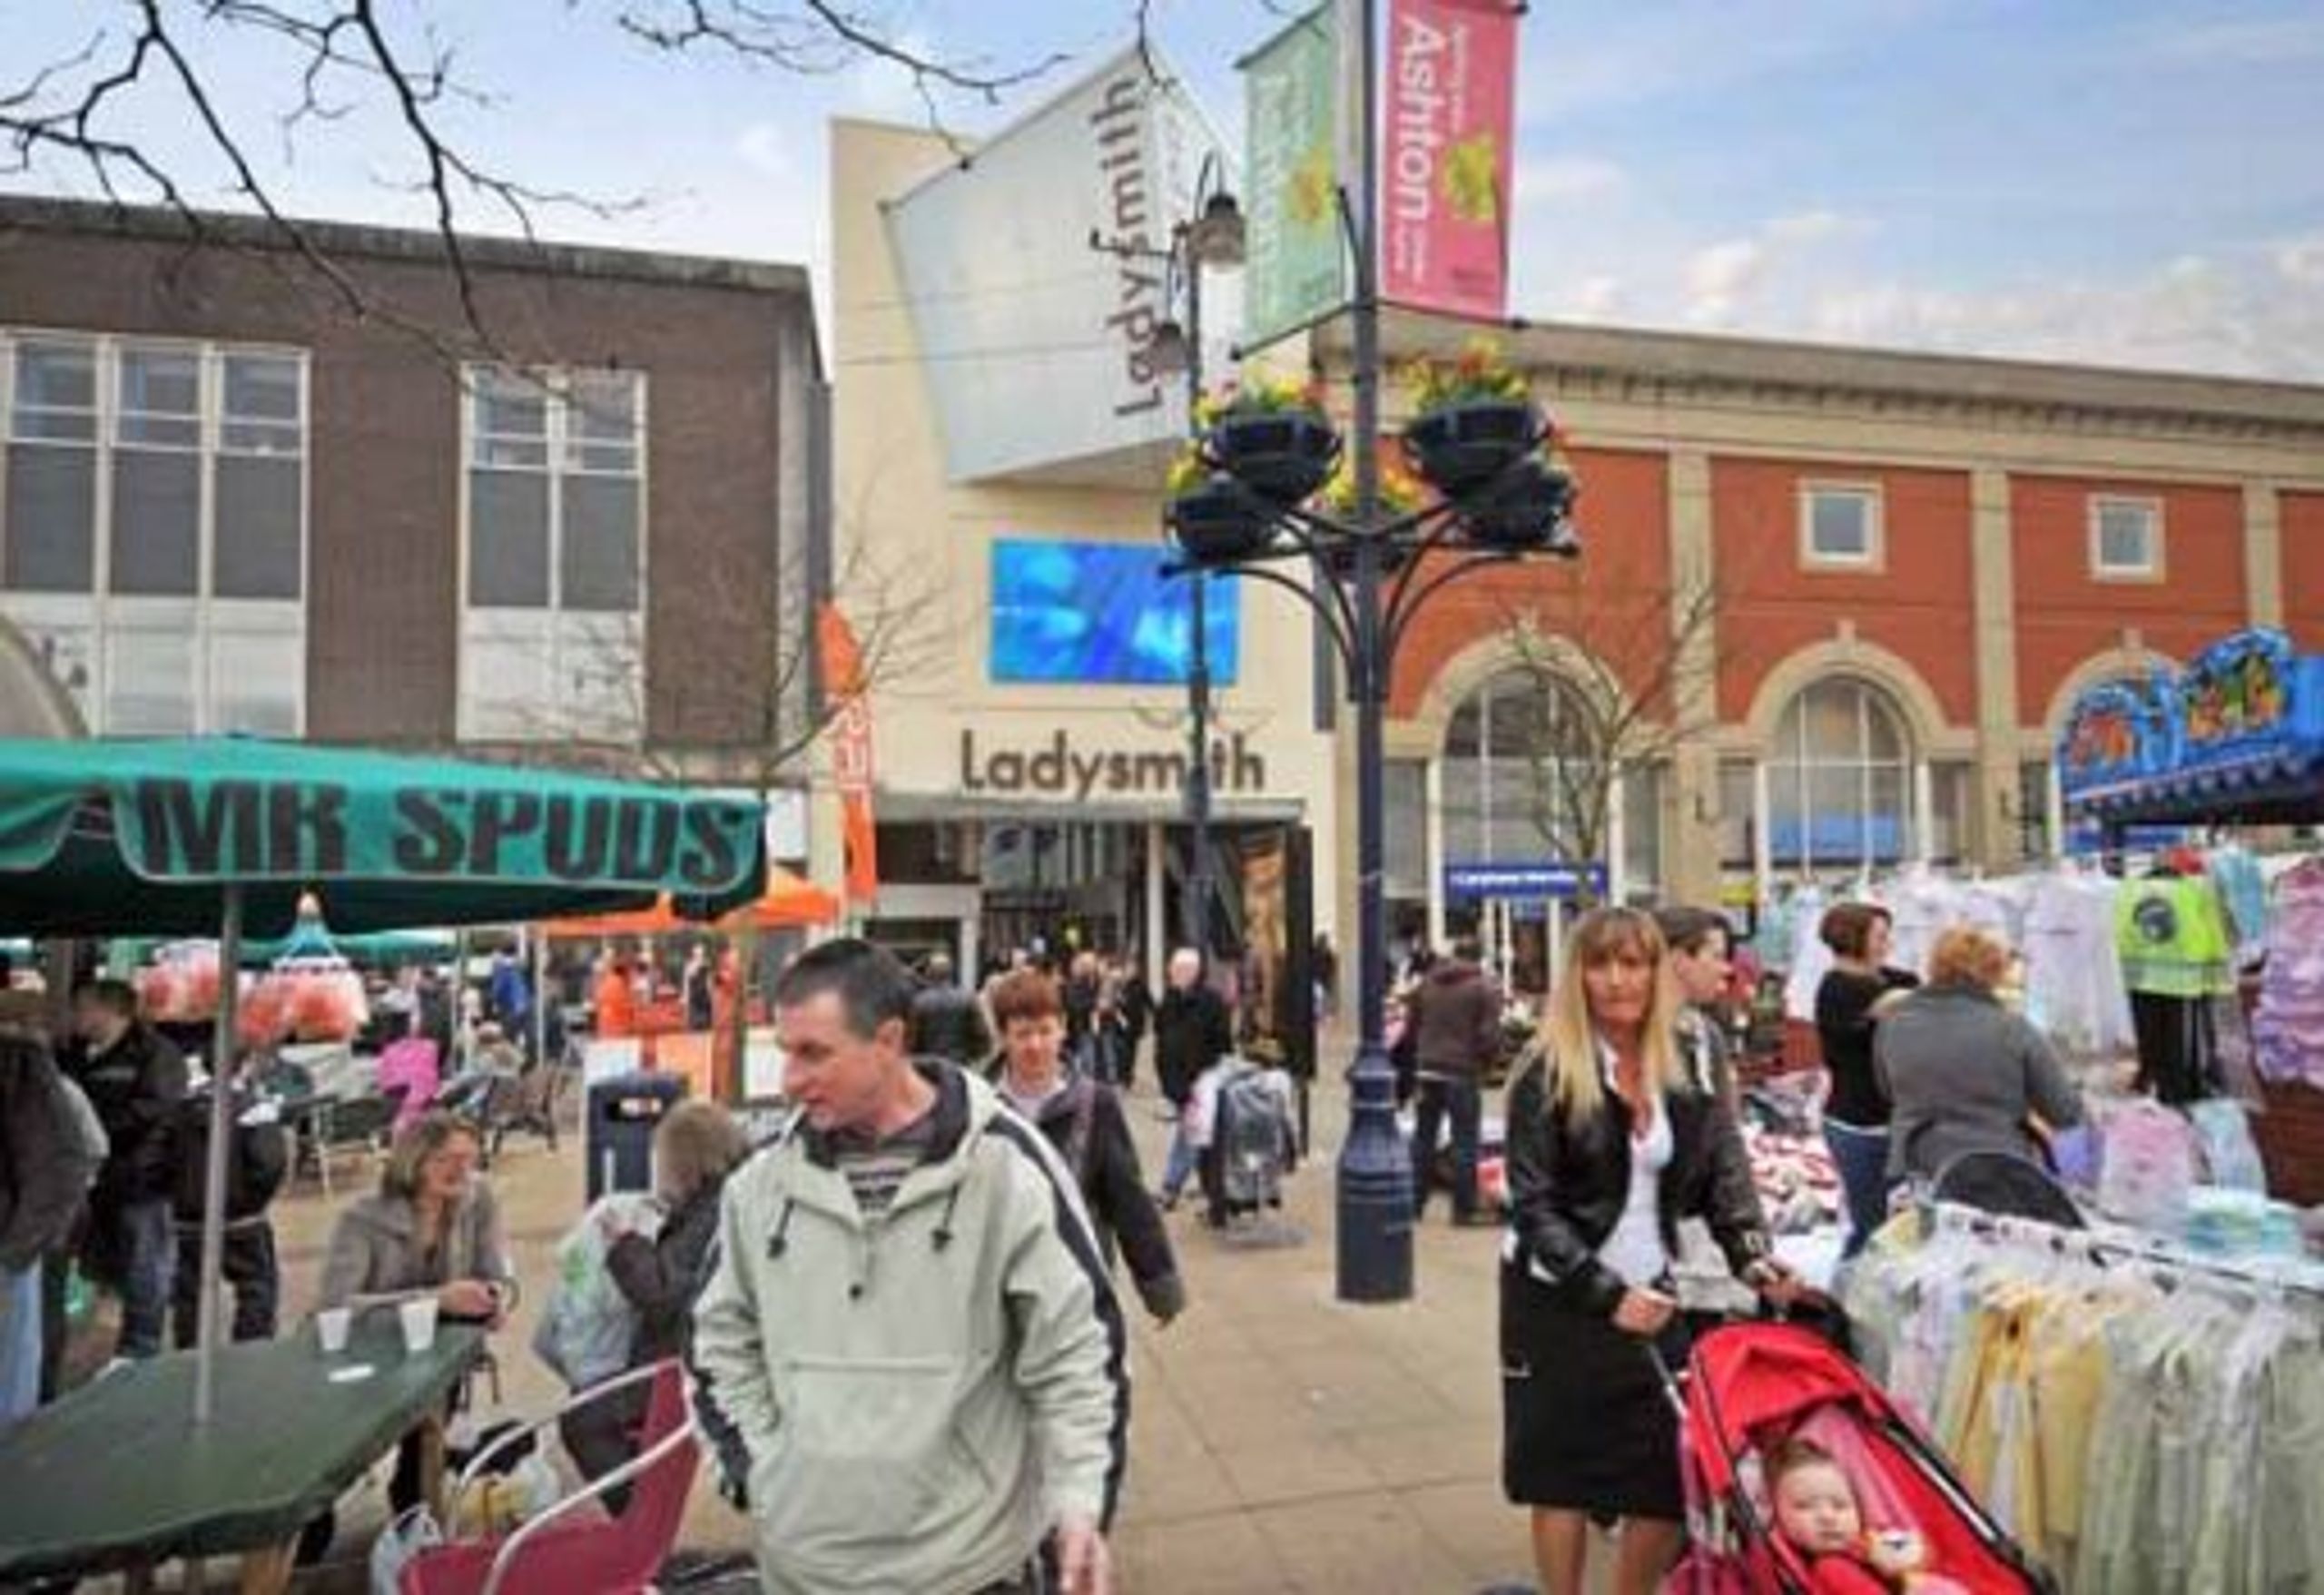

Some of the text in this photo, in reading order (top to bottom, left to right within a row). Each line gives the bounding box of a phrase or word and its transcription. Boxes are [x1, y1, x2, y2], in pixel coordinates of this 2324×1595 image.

[1396, 14, 1448, 222] Ashton
[1091, 76, 1162, 419] Ladysmith
[134, 779, 747, 888] MR SPUDS
[960, 729, 1266, 800] Ladysmth
